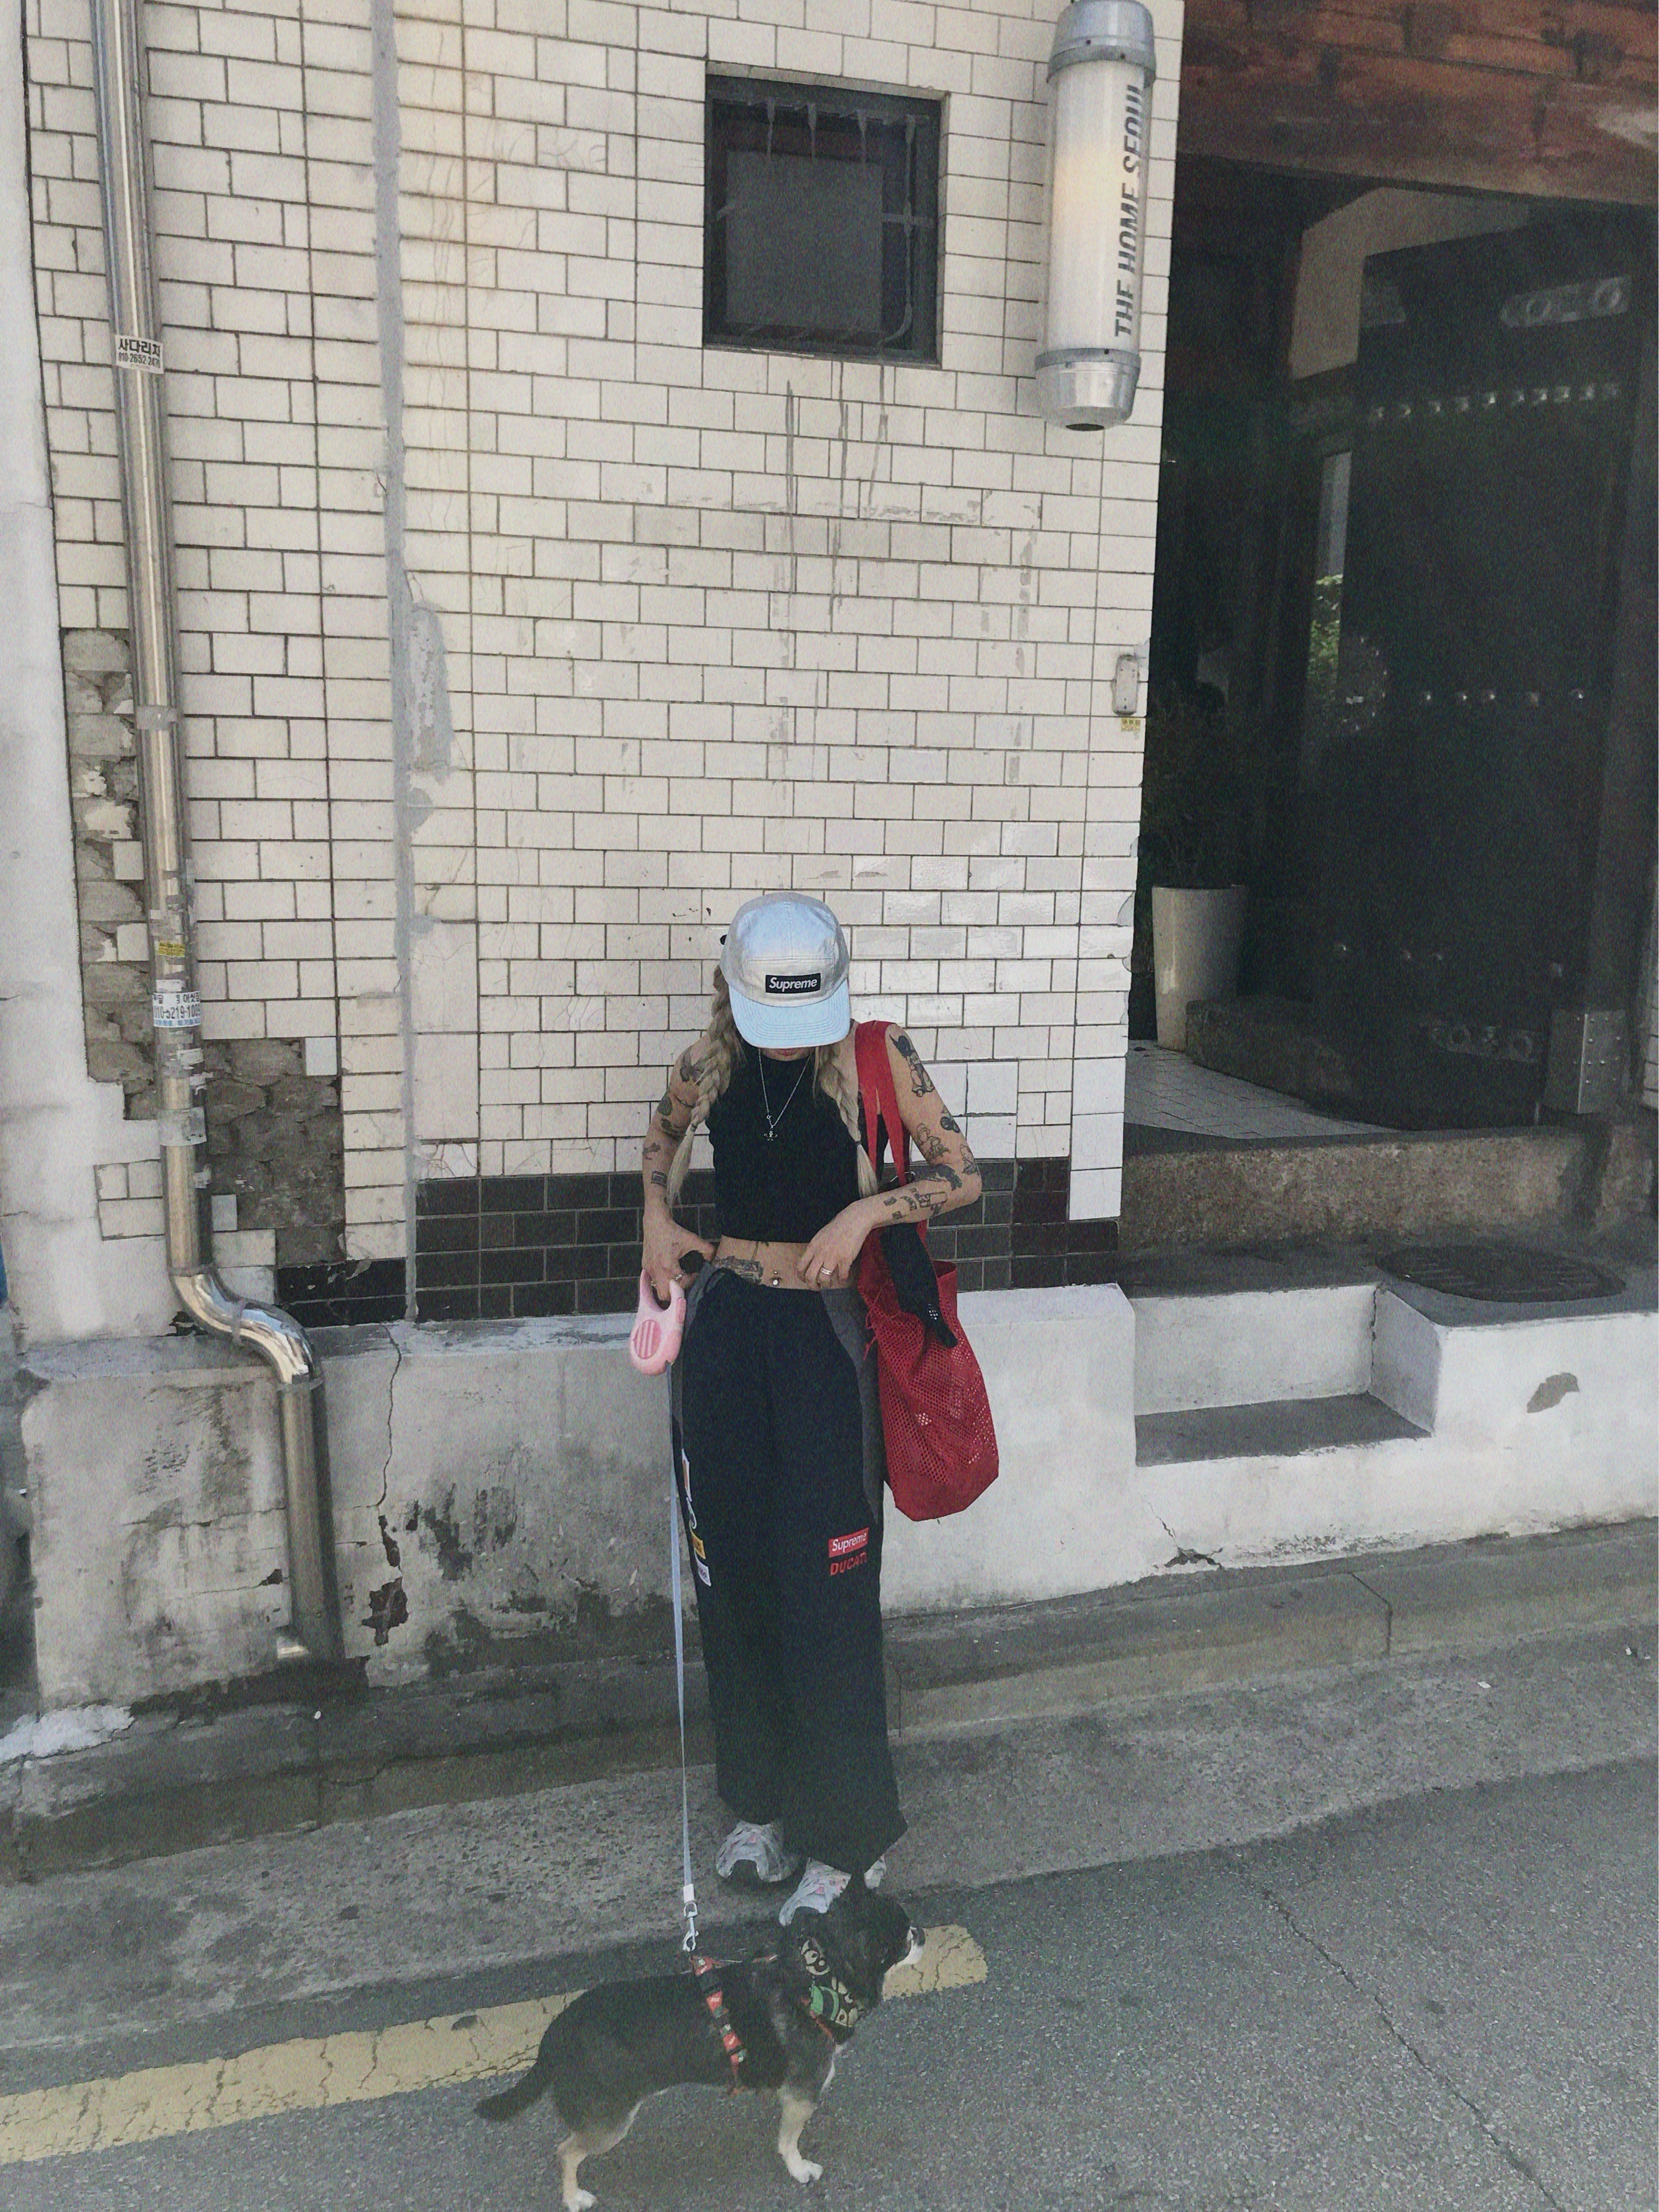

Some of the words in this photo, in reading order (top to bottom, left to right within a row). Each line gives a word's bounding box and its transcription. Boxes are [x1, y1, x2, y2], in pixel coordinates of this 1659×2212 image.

[1123, 84, 1143, 178] SEOUL
[1117, 183, 1139, 274] HOME
[1115, 279, 1133, 337] THE
[118, 338, 161, 358] 사다리차
[769, 977, 817, 992] Supreme
[832, 1532, 867, 1553] Supreme
